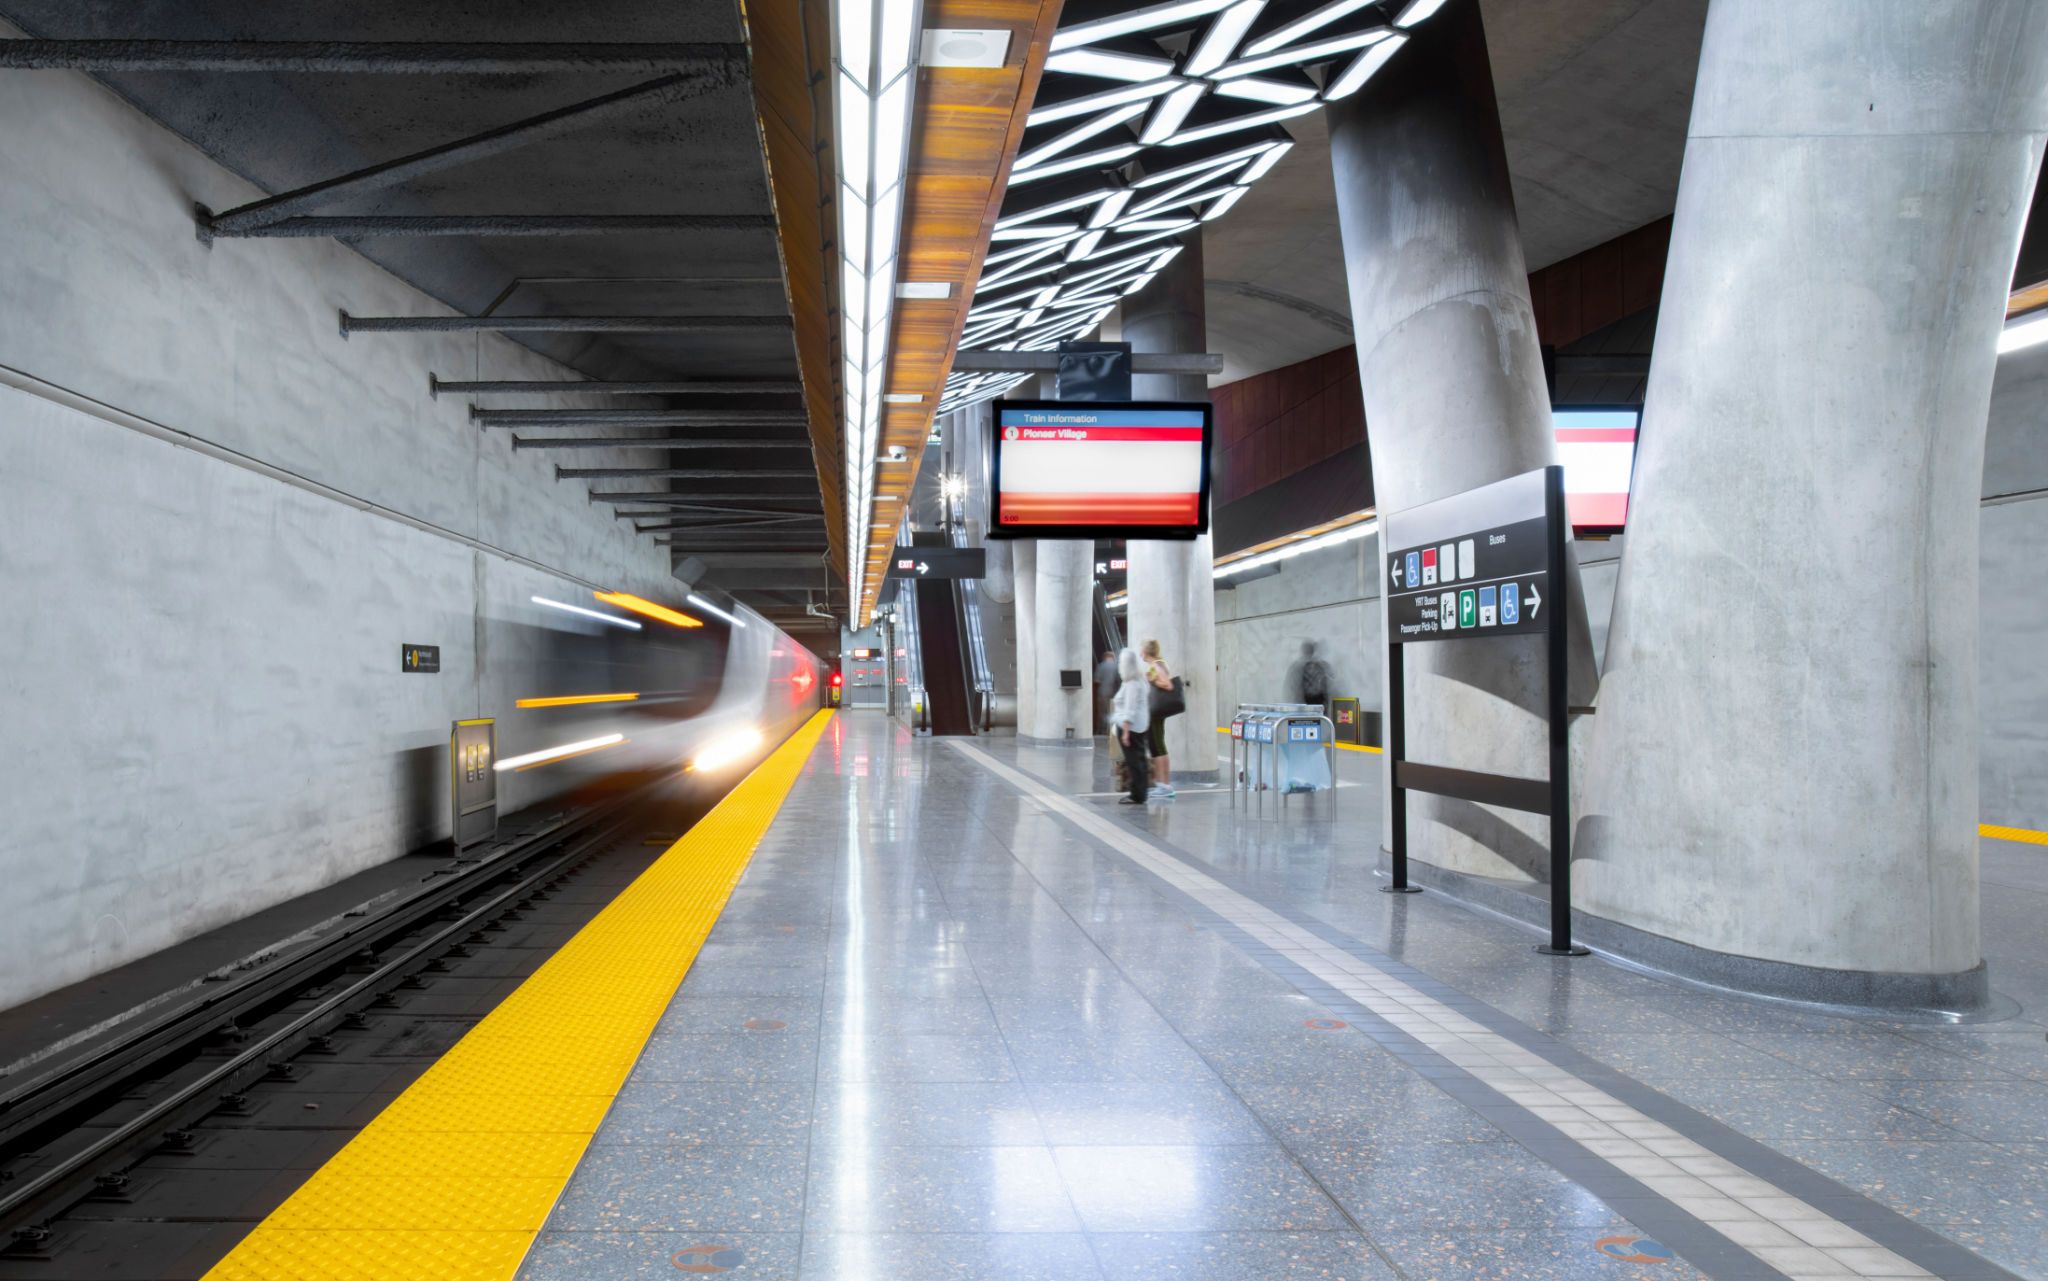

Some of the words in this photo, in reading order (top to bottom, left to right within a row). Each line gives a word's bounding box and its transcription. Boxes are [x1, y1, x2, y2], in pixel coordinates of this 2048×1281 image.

[1024, 414, 1046, 423] Train
[1048, 413, 1097, 423] Information
[1023, 429, 1056, 438] Pioneer
[1057, 429, 1087, 440] Village
[1490, 534, 1506, 546] Buses
[898, 559, 913, 569] EXIT
[1110, 560, 1127, 569] EXIT
[1424, 596, 1438, 606] Buses
[1421, 608, 1438, 620] Parking
[1400, 623, 1421, 635] Passenger
[1421, 621, 1438, 633] Pick-Up
